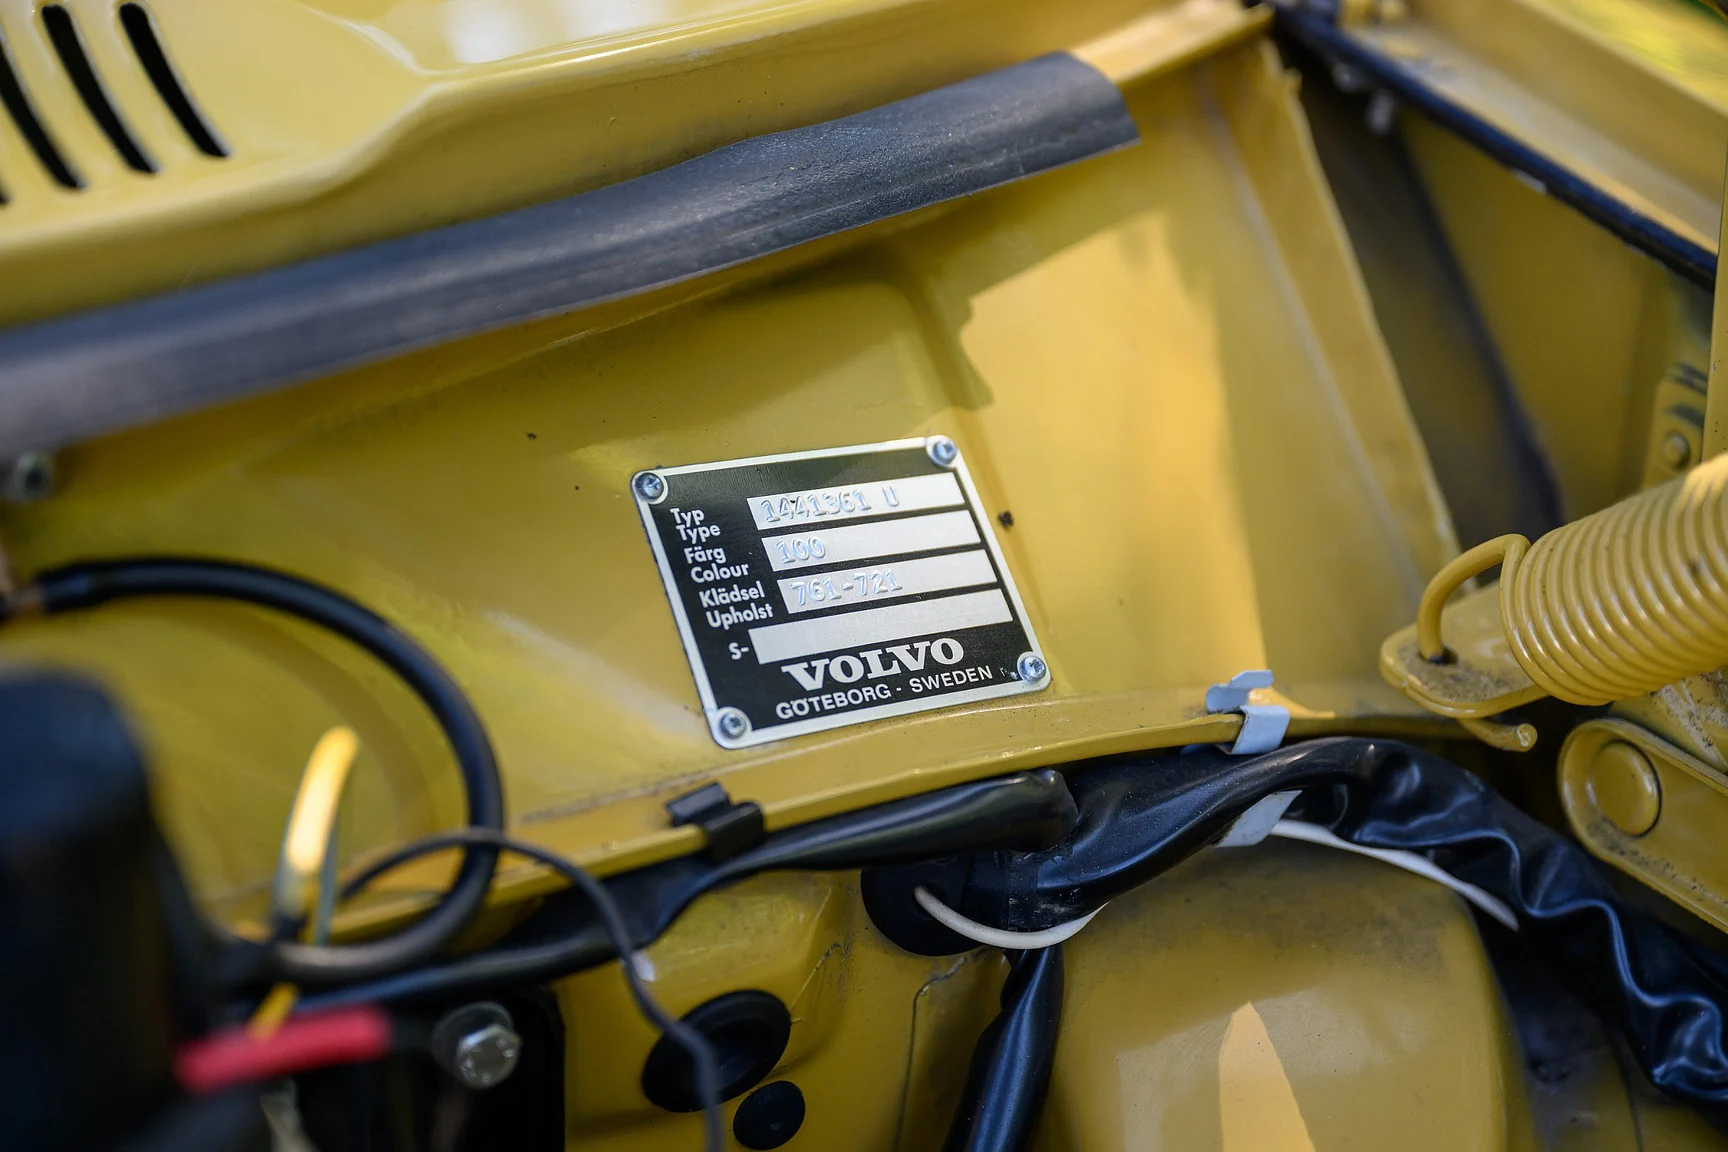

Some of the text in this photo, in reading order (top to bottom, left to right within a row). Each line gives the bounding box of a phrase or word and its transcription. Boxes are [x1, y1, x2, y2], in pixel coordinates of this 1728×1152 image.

[670, 507, 705, 527] Typ
[761, 483, 900, 523] 1441361 U
[676, 524, 721, 545] Type
[683, 545, 727, 565] Färg
[776, 535, 826, 564] 100
[690, 562, 749, 584] Colour
[790, 568, 903, 606] 761-721
[698, 580, 766, 608] Klädsel
[705, 602, 774, 631] Upholst
[780, 637, 965, 692] VOLVO
[775, 684, 892, 720] GÖTEBORG
[908, 664, 993, 694] SWEDEN
